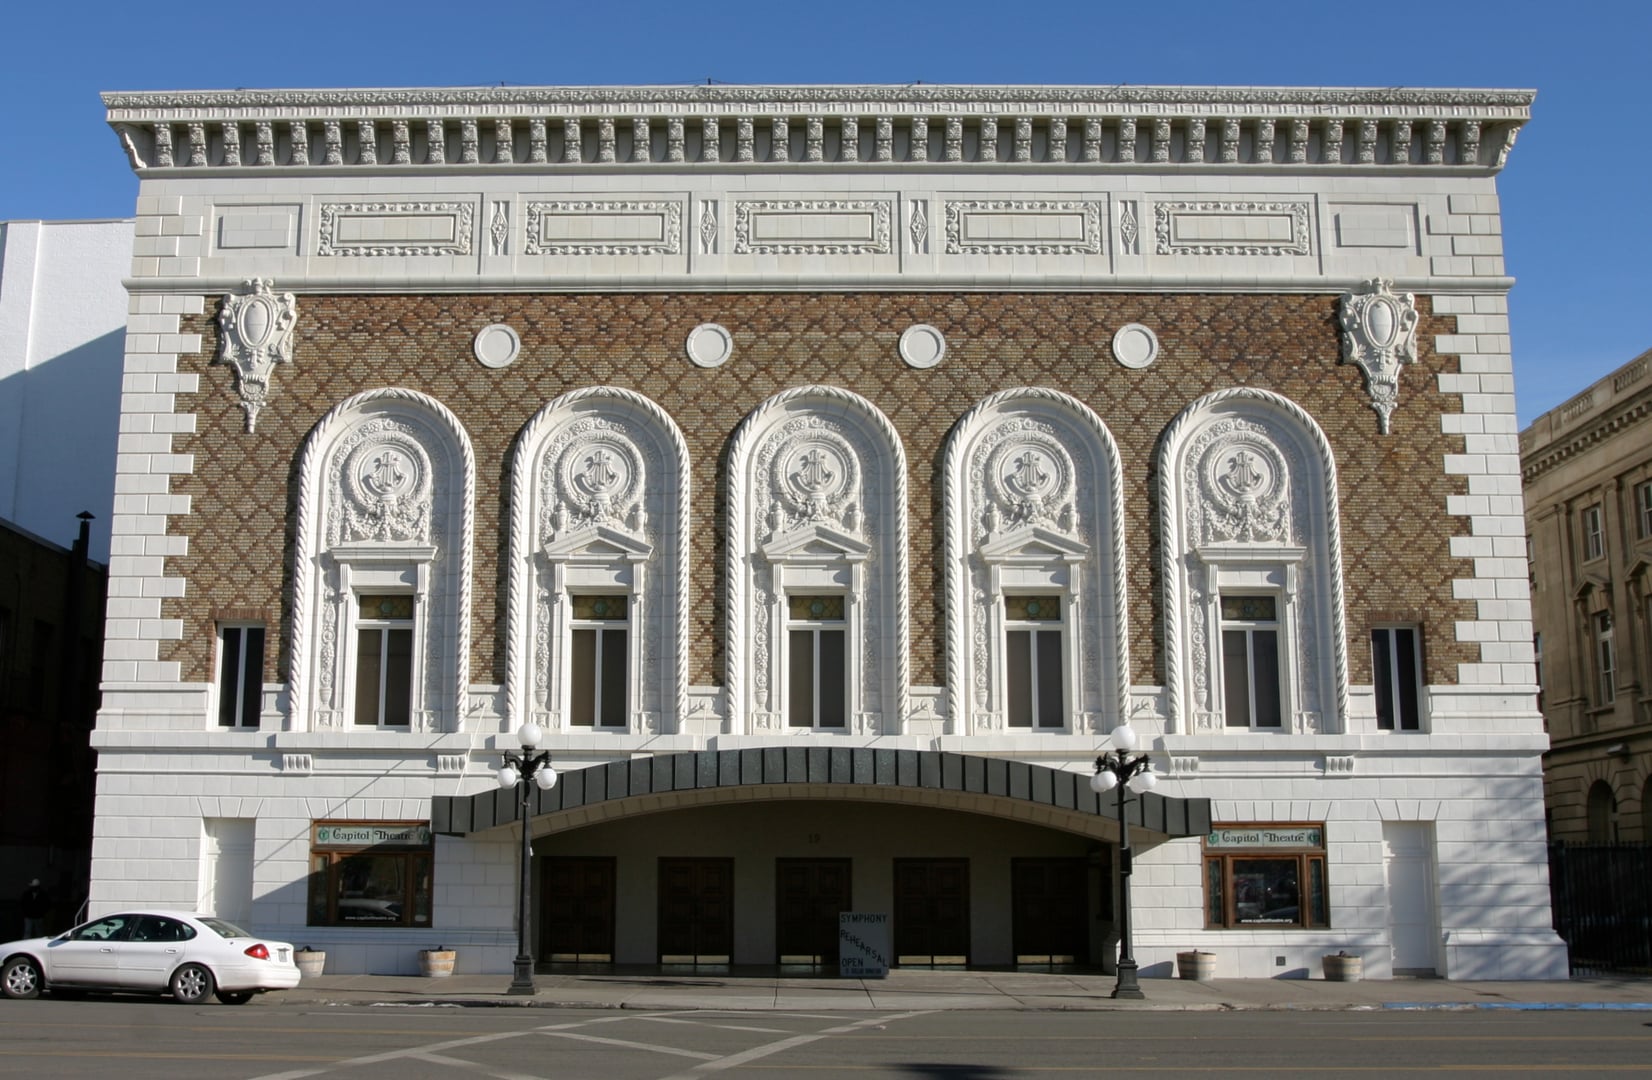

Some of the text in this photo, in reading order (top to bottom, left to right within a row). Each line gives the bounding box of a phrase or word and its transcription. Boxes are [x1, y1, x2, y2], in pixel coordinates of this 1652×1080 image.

[333, 828, 369, 841] Capitol
[1222, 831, 1305, 844] Capitol Theatre
[840, 914, 887, 923] SYMPHONY
[840, 929, 888, 967] REHEARSAL
[842, 958, 864, 967] OPEN
